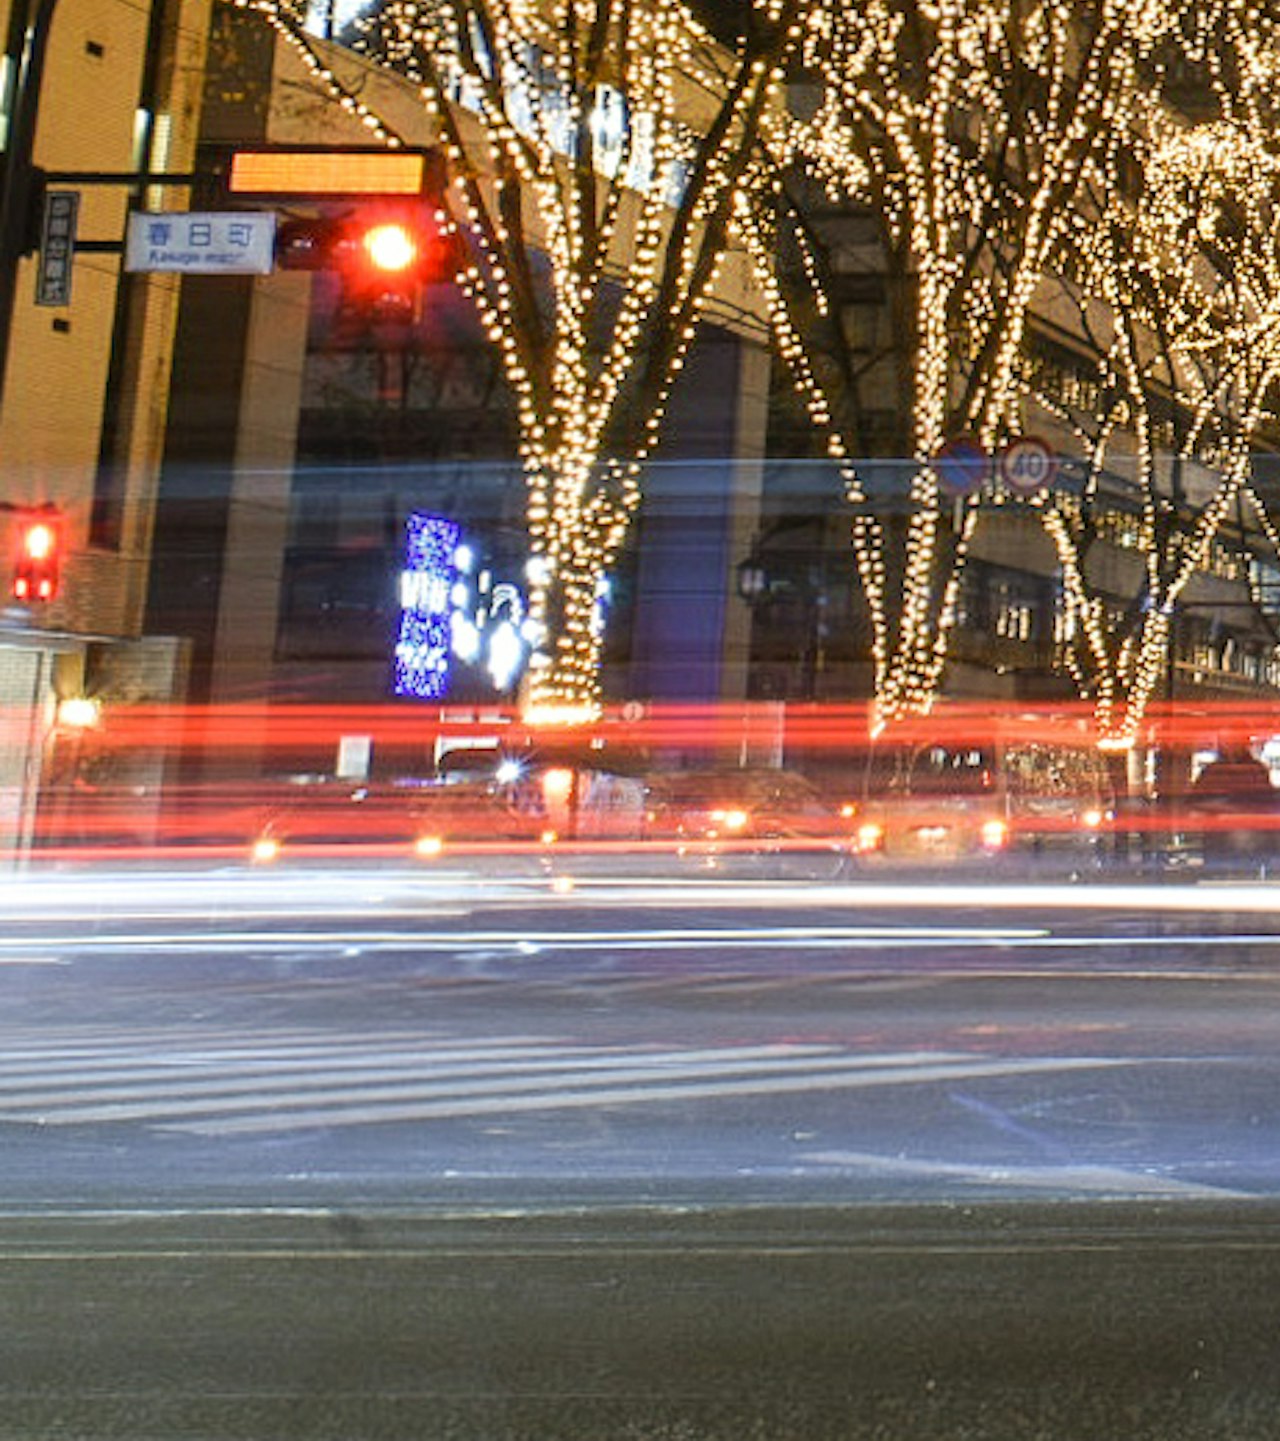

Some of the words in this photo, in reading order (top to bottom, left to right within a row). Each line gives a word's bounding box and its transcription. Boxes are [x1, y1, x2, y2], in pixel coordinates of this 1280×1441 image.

[149, 222, 252, 247] 春日町
[1012, 453, 1042, 478] 40
